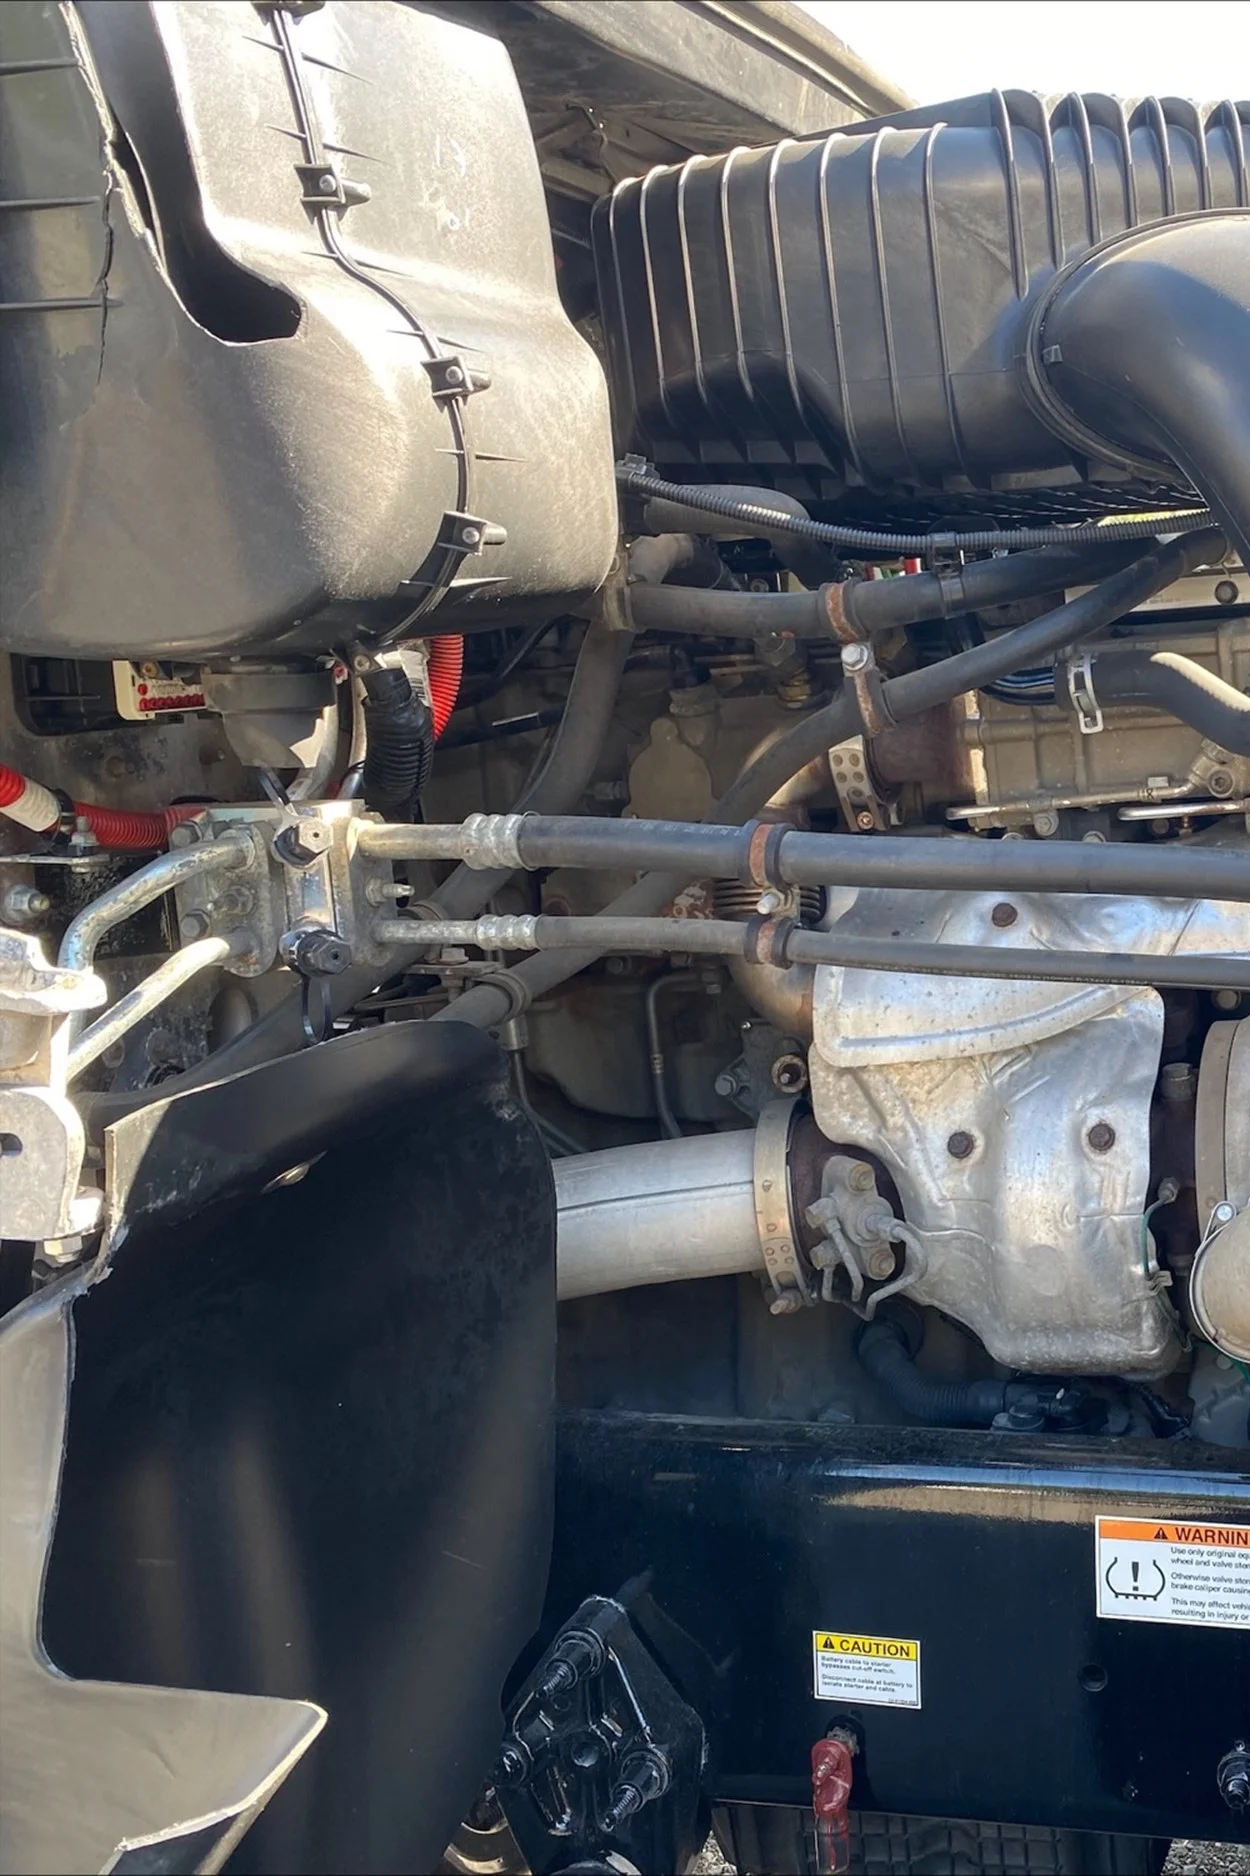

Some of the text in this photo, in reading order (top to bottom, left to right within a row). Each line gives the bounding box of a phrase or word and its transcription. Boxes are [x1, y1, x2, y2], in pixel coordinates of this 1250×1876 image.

[1170, 1547, 1186, 1555] Use
[1188, 1549, 1204, 1558] only
[1206, 1550, 1236, 1558] original
[1170, 1557, 1193, 1565] wheel
[1195, 1559, 1210, 1567] and
[1171, 1572, 1210, 1582] Otherwise
[1171, 1582, 1193, 1590] brake
[1194, 1584, 1221, 1593] caliper
[1171, 1597, 1188, 1605] This
[1189, 1600, 1206, 1608] may
[1208, 1601, 1230, 1609] affect
[1171, 1609, 1206, 1619] resulting
[1207, 1610, 1215, 1618] in
[1217, 1611, 1239, 1621] injury
[840, 1639, 910, 1657] CAUTION
[883, 1680, 904, 1688] battery
